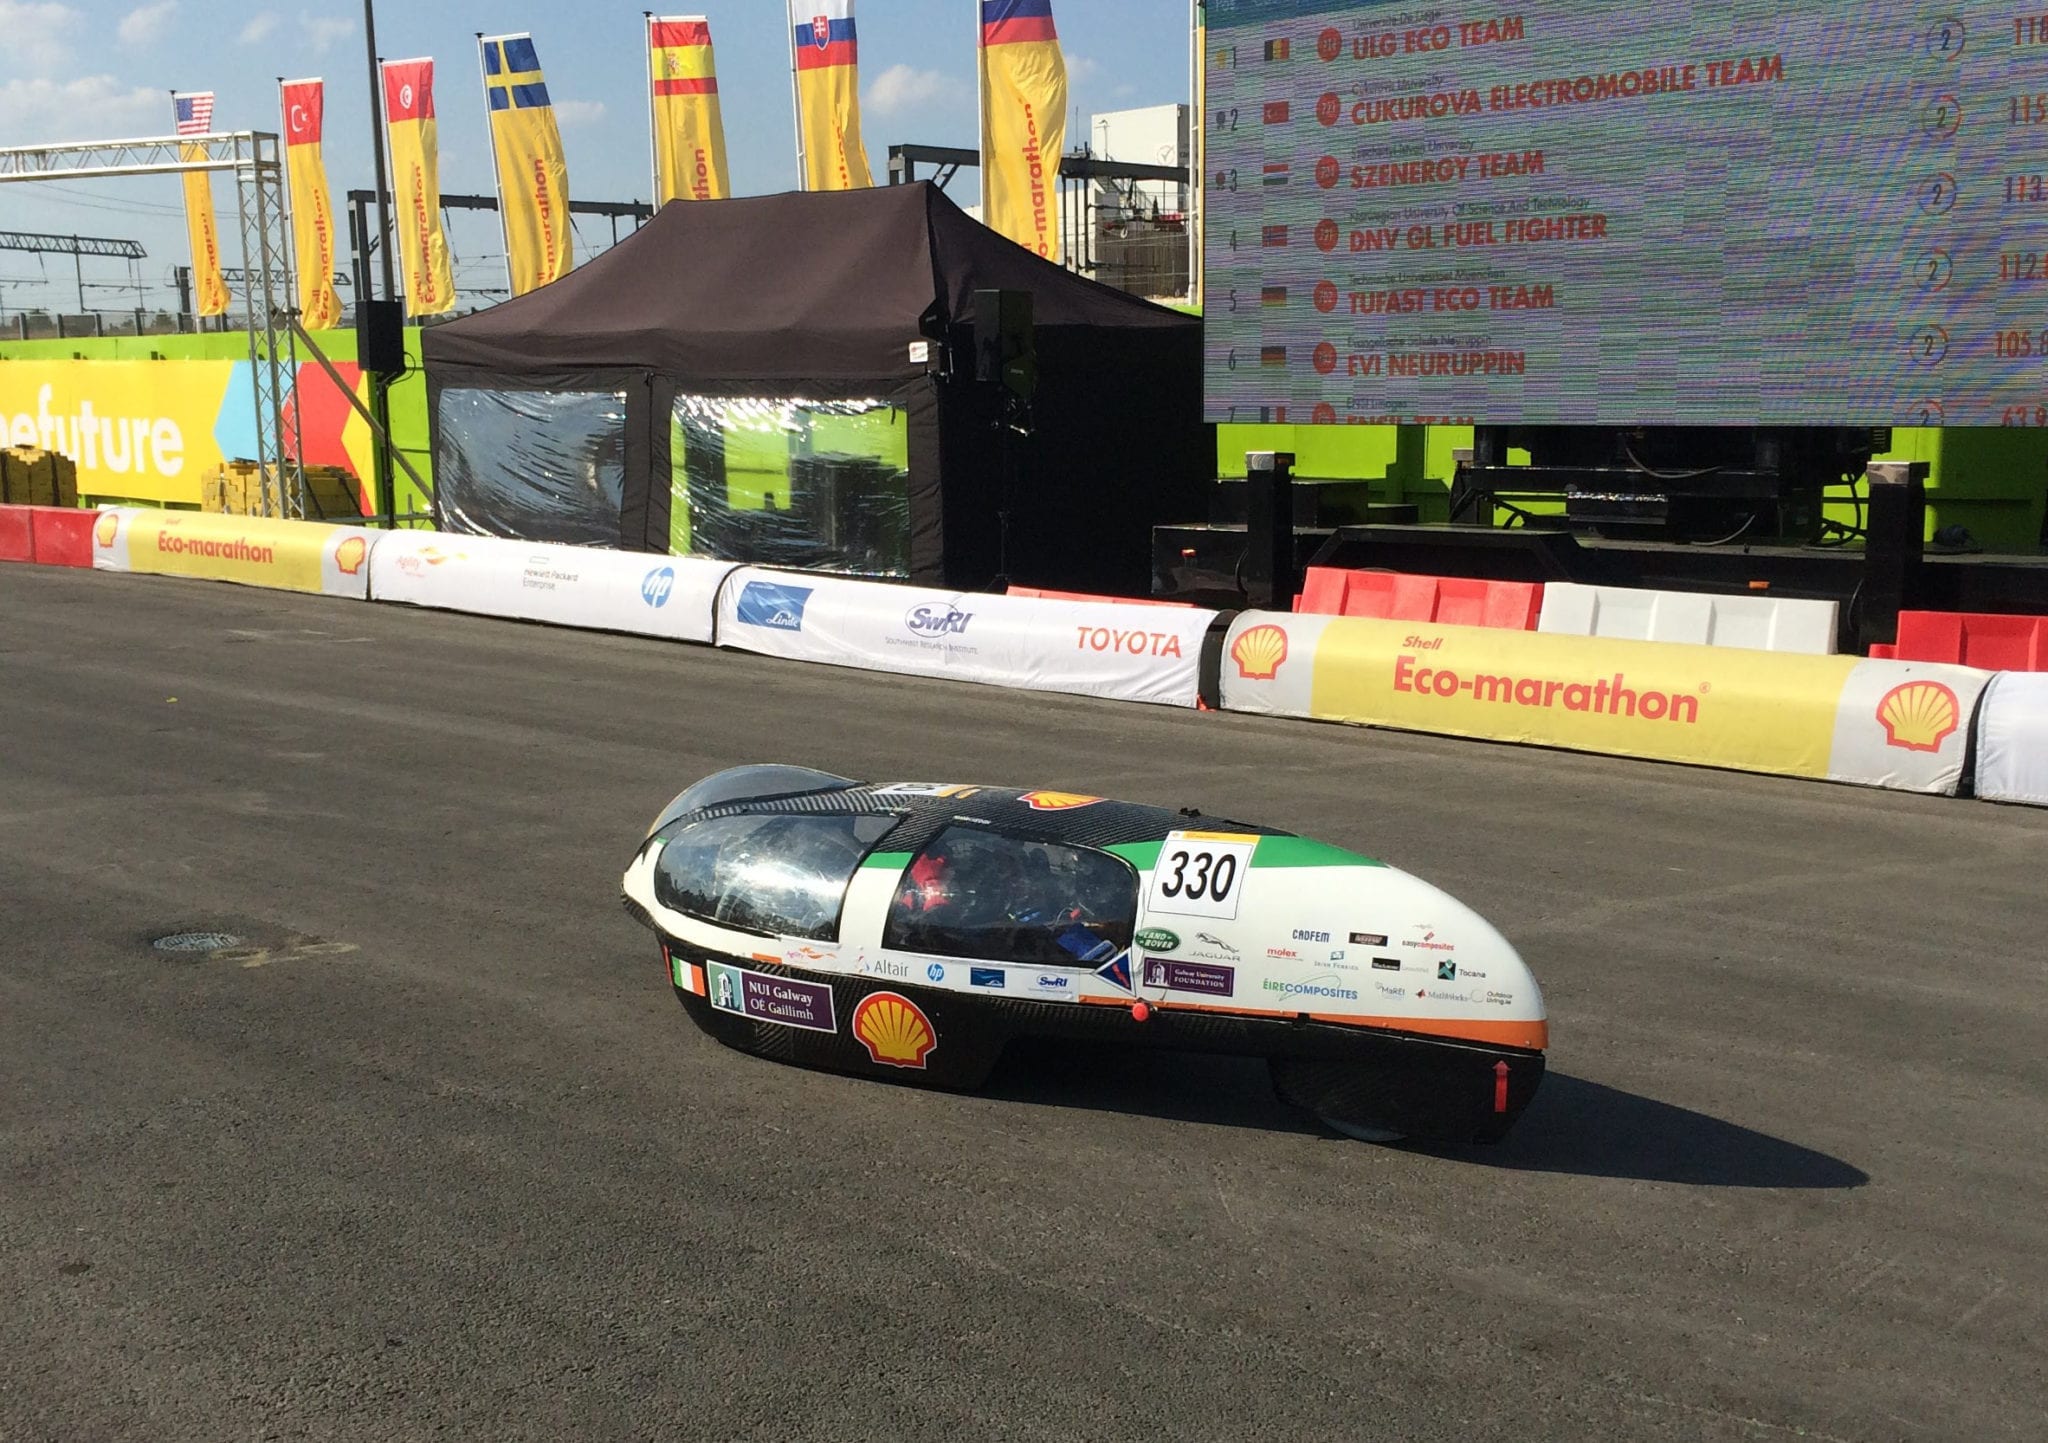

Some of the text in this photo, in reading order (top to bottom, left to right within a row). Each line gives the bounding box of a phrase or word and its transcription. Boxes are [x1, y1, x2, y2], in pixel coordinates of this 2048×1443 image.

[1353, 34, 1396, 60] ULG
[1405, 26, 1450, 53] ECO
[1458, 17, 1524, 48] TEAM
[1351, 89, 1482, 125] CUKUROVA
[1490, 64, 1695, 112] ELECTROMOBILE
[1706, 54, 1784, 88] TEAM
[1351, 156, 1471, 190] SZENERGY
[1478, 150, 1544, 179] TEAM
[1351, 228, 1400, 251] DNV
[1407, 225, 1436, 250] GL
[1444, 221, 1498, 247] FUEL
[1505, 214, 1608, 243] FIGHTER
[1350, 289, 1426, 314] TUFAST
[1434, 286, 1480, 311] ECO
[1487, 284, 1554, 309] TEAM
[1348, 354, 1381, 377] EVI
[1388, 351, 1525, 376] NEURUPPIN
[158, 530, 273, 564] Eco-marathon
[642, 567, 674, 608] hp
[765, 610, 799, 628] Linde
[909, 608, 974, 634] SwRI
[1077, 626, 1182, 659] TOYOTA
[1402, 635, 1443, 651] Shell
[1393, 655, 1699, 725] Eco-marathon
[1161, 850, 1237, 902] 330
[1144, 931, 1166, 940] LAND
[1145, 940, 1174, 949] ROVER
[1189, 951, 1241, 961] JAGUAR
[1267, 948, 1298, 958] molex
[874, 960, 909, 978] Altair
[927, 963, 944, 982] hp
[1459, 968, 1486, 979] Tocana
[749, 981, 814, 1005] NUI Galway
[1174, 976, 1225, 988] FOUNDATION
[768, 1002, 814, 1020] Gaillimh
